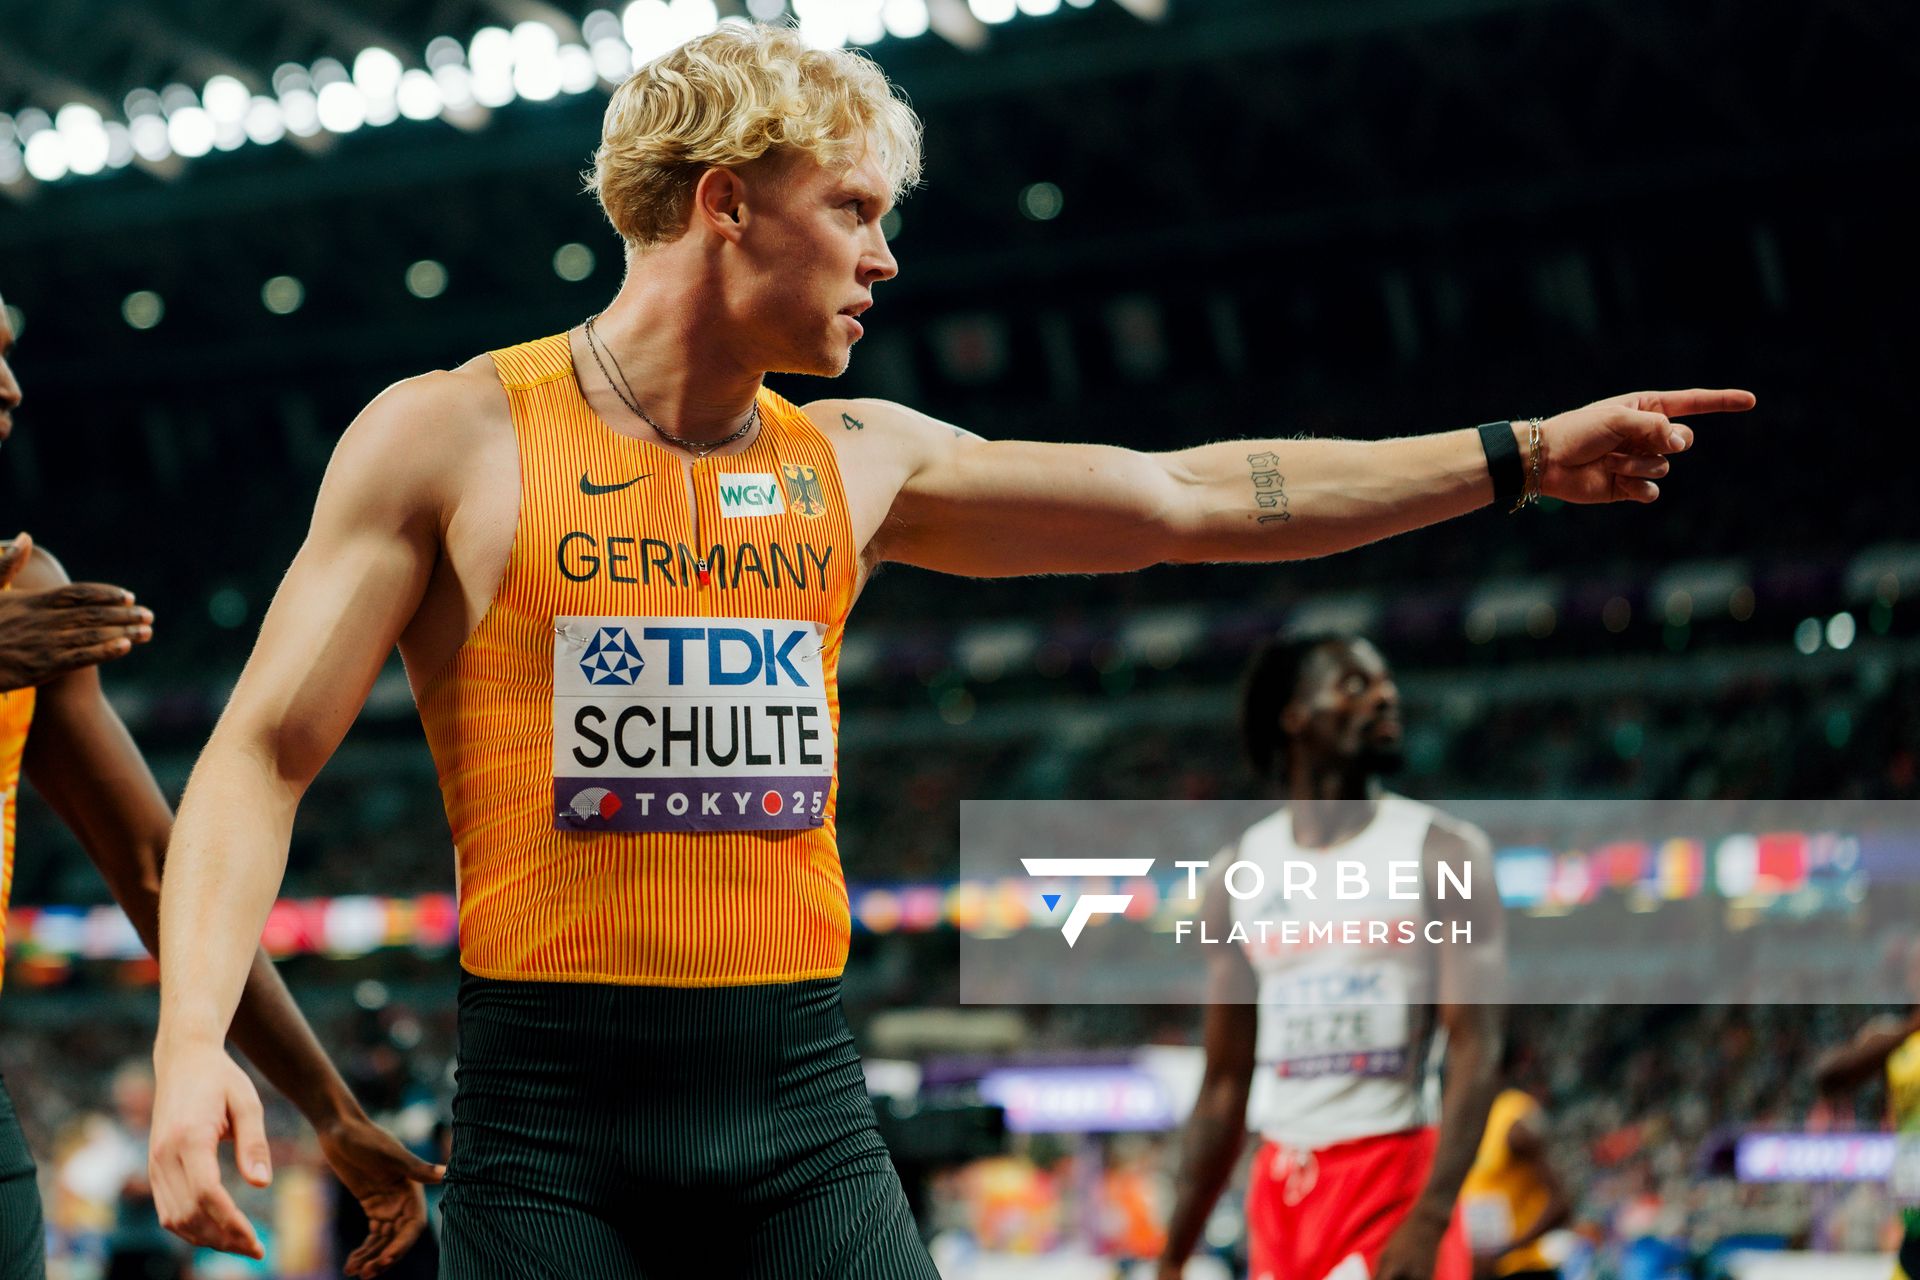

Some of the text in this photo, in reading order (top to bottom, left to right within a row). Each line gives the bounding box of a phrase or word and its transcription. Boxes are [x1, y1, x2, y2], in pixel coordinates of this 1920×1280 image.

[720, 483, 777, 508] WGV
[557, 531, 833, 592] GERMANY
[643, 627, 811, 688] TDK
[572, 705, 823, 769] SCHULTE
